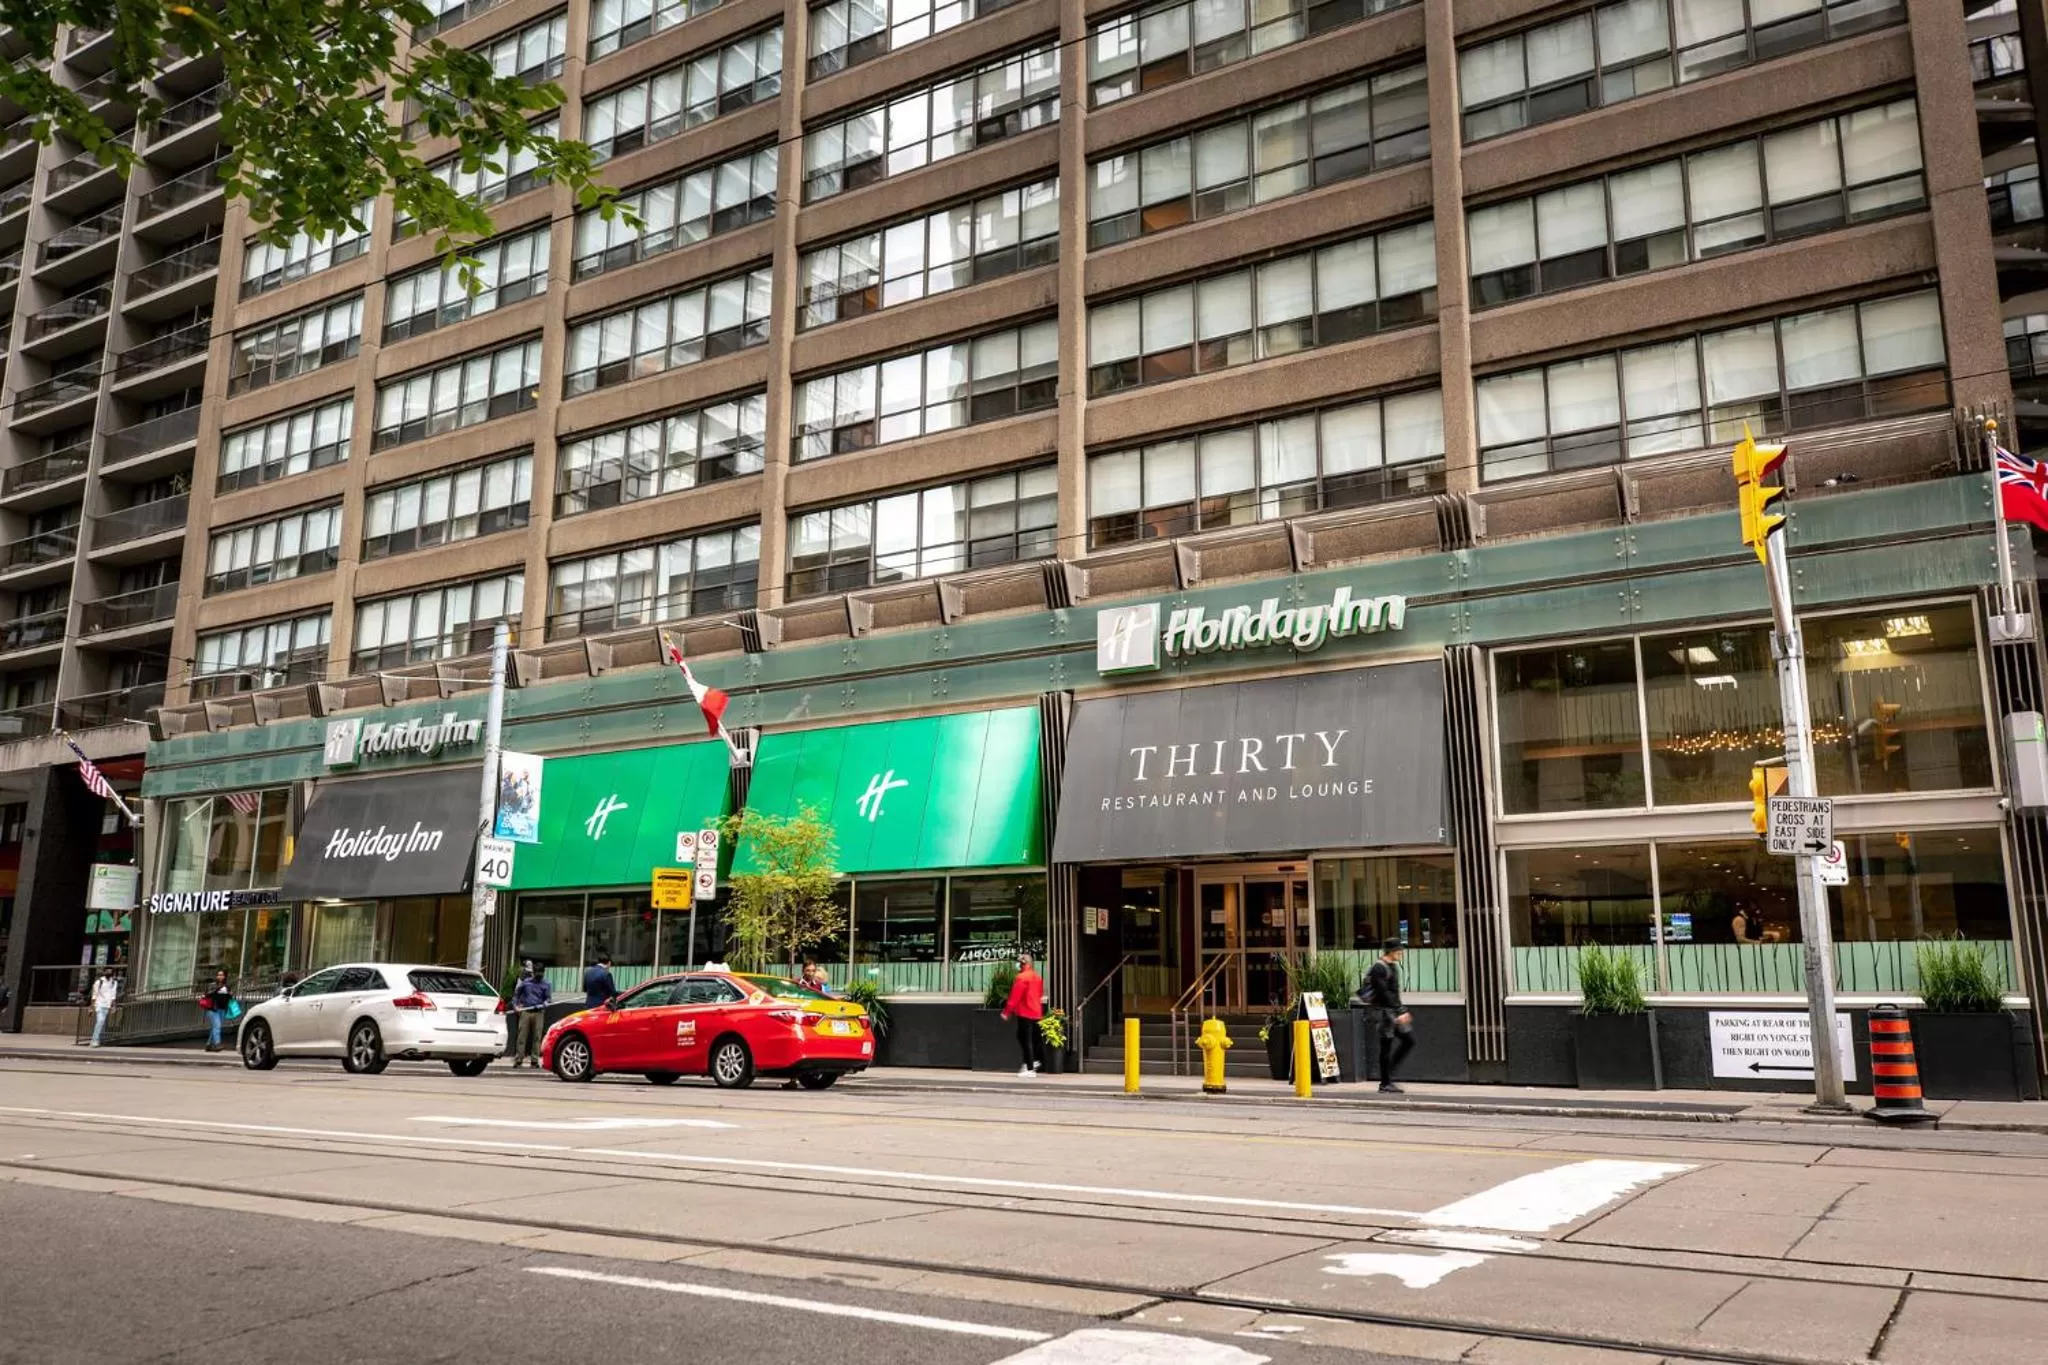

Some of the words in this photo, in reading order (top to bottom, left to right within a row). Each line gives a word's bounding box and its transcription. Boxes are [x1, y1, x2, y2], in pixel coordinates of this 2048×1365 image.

[1164, 597, 1330, 654] Holiday
[1329, 586, 1406, 635] Inn
[359, 717, 440, 754] Holiday
[439, 711, 483, 743] Inn
[1129, 729, 1349, 782] THIRTY
[1101, 789, 1227, 812] RESTAURANT
[1238, 786, 1278, 802] AND
[1289, 778, 1374, 800] LOUNGE
[1771, 800, 1830, 813] PEDESTRIANS
[1776, 813, 1805, 825] CROSS
[1813, 814, 1825, 826] AT
[1774, 826, 1797, 838] EAST
[1806, 827, 1826, 839] SIDE
[324, 825, 408, 862] Holiday
[405, 821, 444, 853] Inn
[1772, 840, 1796, 850] ONLY
[481, 858, 509, 880] 40
[150, 890, 231, 914] SIGNATURE
[1715, 1018, 1750, 1027] PARKING
[1751, 1019, 1762, 1027] AT
[1762, 1019, 1785, 1028] REAR
[1786, 1020, 1796, 1028] OF
[1730, 1033, 1755, 1042] RIGHT
[1757, 1034, 1770, 1042] ON
[1769, 1034, 1798, 1042] YONGE
[1722, 1047, 1743, 1056] THEN
[1744, 1048, 1769, 1056] RIGHT
[1771, 1048, 1783, 1056] ON
[1784, 1048, 1811, 1057] WOOD
